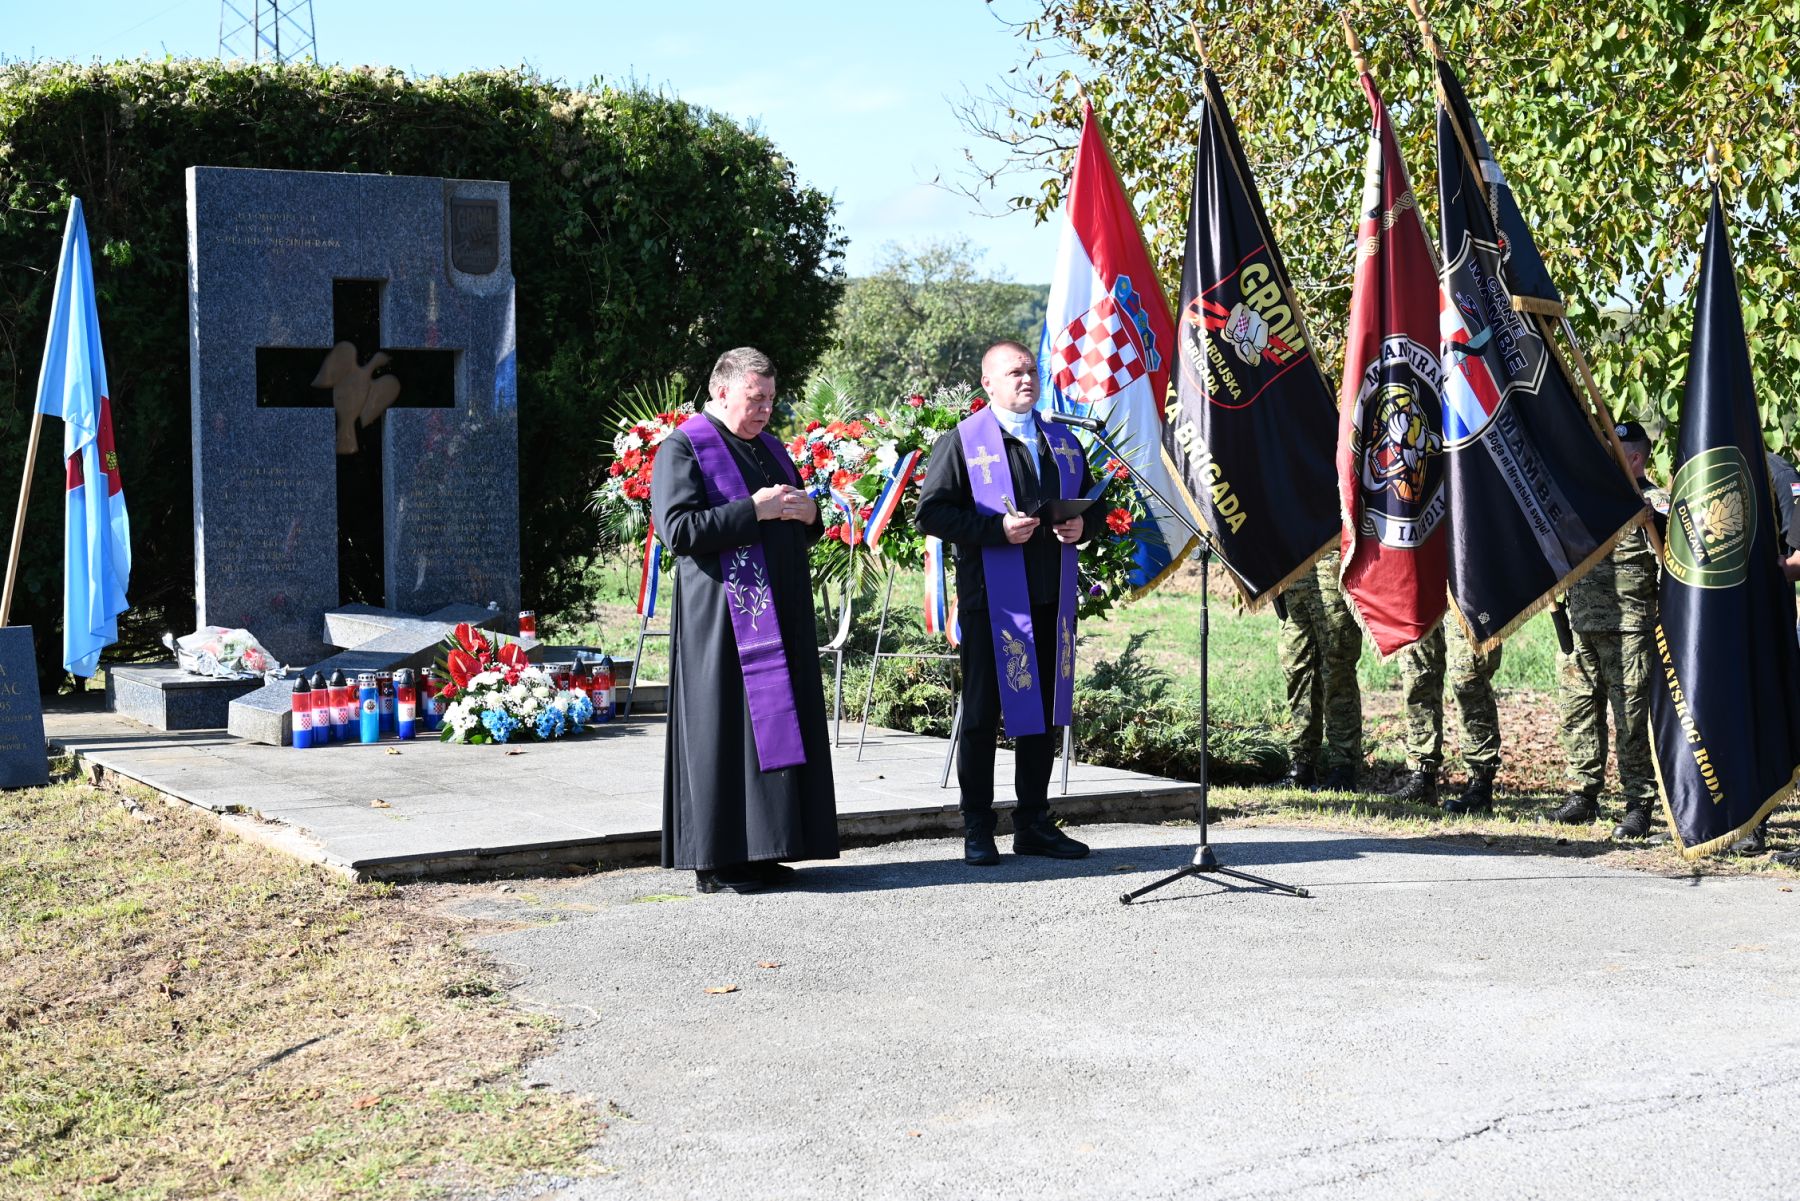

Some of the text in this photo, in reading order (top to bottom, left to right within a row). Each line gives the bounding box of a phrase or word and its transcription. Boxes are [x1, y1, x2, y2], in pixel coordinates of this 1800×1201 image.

[1239, 262, 1306, 362] GROM
[1468, 256, 1529, 377] MAMBE
[1486, 276, 1527, 340] CRNE
[1183, 338, 1220, 396] BRIGADA
[1197, 328, 1242, 401] GARDIJSKA
[1174, 420, 1248, 534] BRIGADA
[1486, 430, 1505, 457] Boga
[1506, 465, 1534, 509] Hrvatsku
[1530, 508, 1551, 536] svoju!
[1678, 505, 1706, 562] DUBRAVA
[1655, 624, 1725, 806] HRVATSKOG RODA
